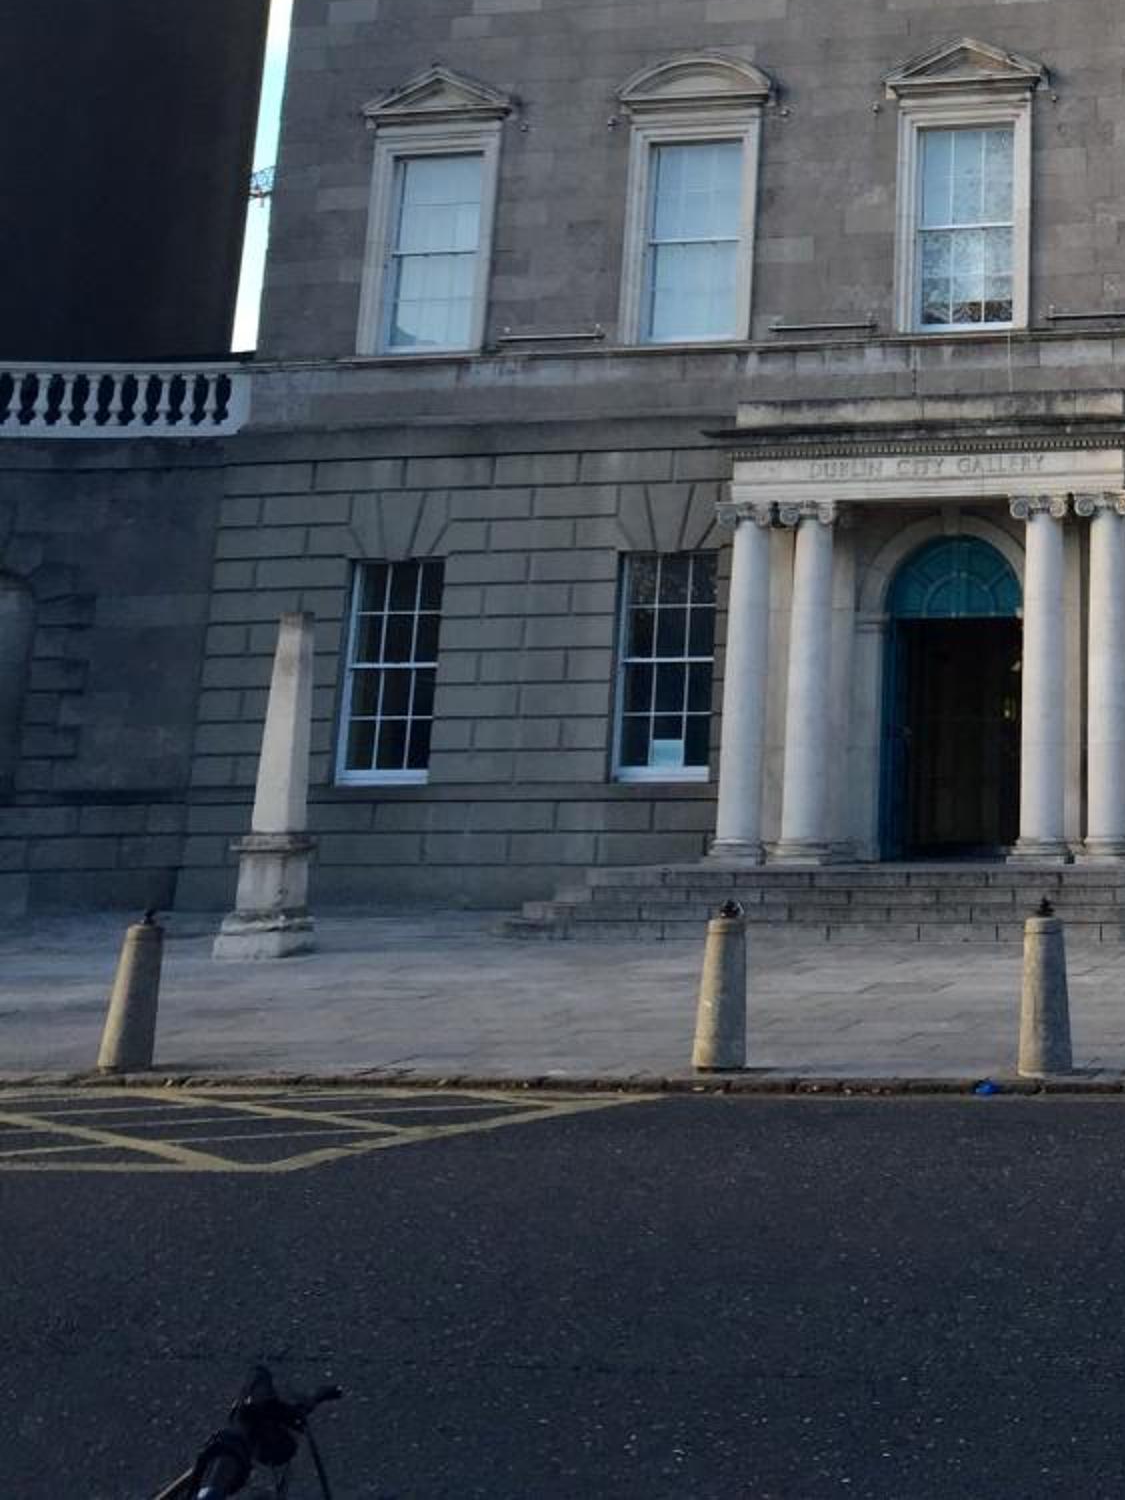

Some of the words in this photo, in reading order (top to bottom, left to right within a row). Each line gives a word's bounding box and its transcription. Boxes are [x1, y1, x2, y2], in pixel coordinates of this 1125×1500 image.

[808, 458, 883, 479] DUBLIN
[897, 457, 945, 476] CITY
[956, 453, 1045, 474] GALLERY
